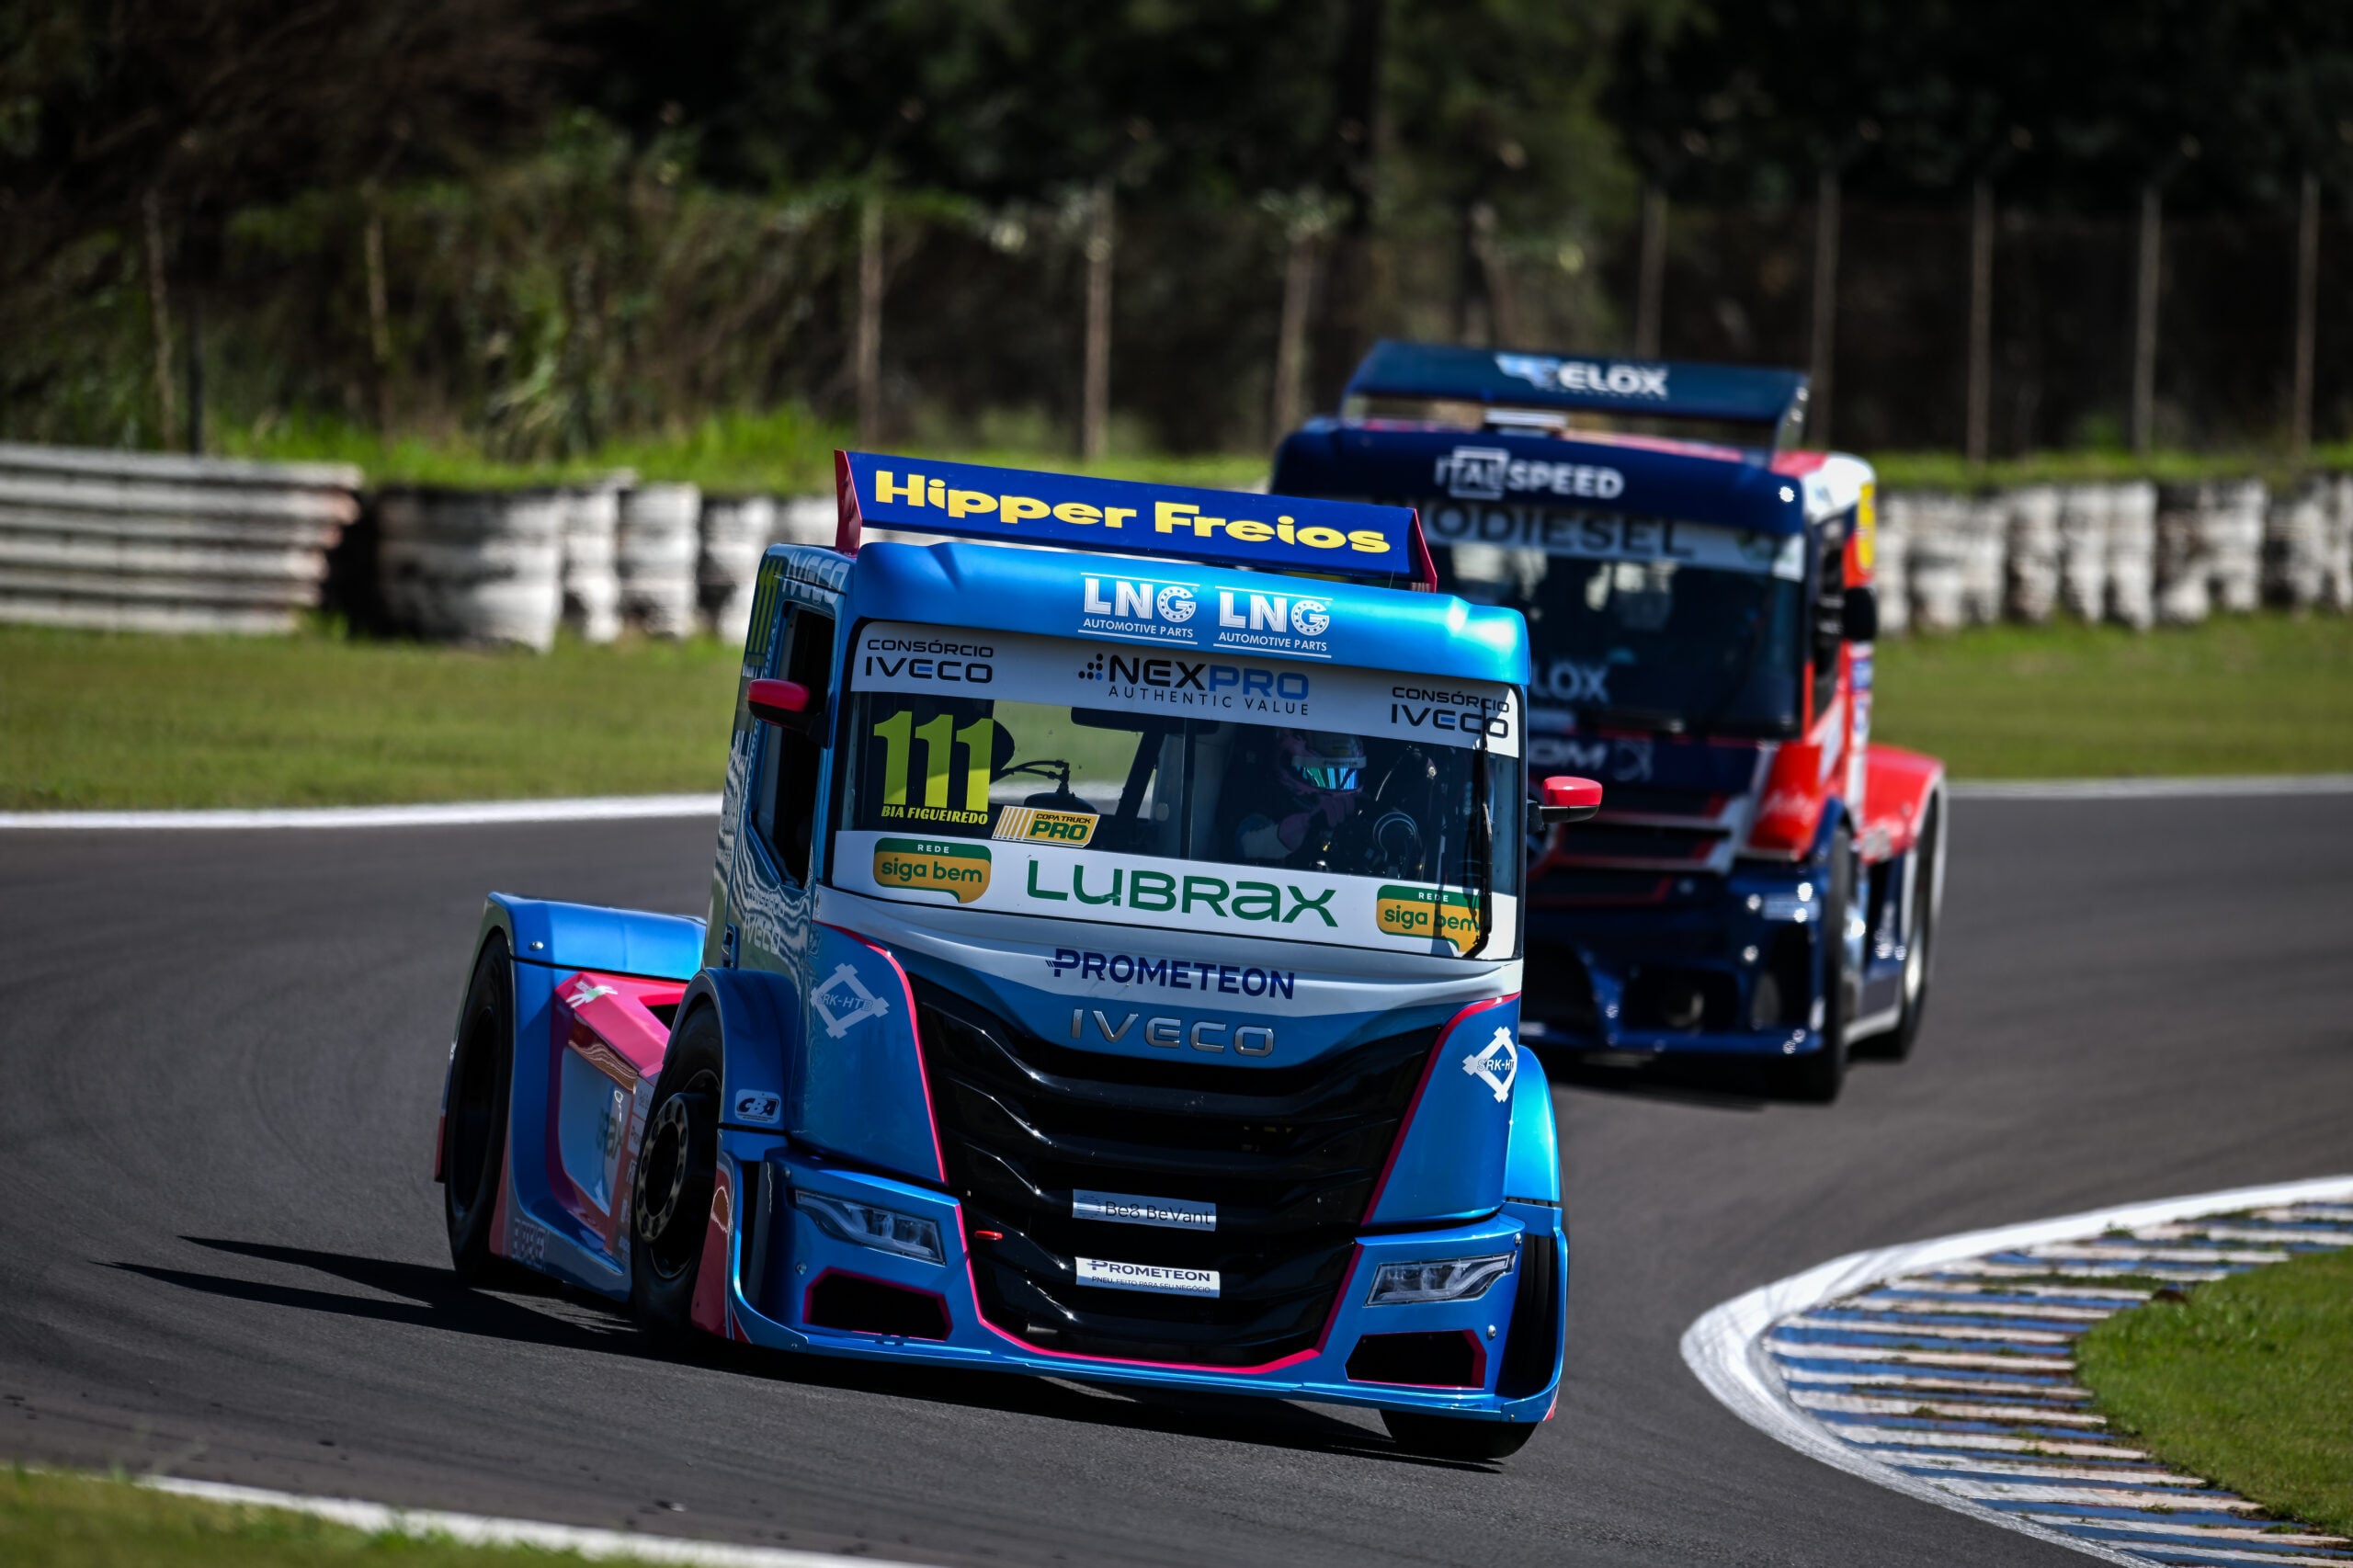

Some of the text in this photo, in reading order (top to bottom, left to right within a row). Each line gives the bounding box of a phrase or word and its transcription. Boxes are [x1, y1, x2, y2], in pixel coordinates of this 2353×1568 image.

[876, 471, 1391, 553] Hipper Freios
[1084, 578, 1197, 623] LNG
[1219, 591, 1330, 636] LNG
[1083, 618, 1194, 638] AUTOMOTIVE PARTS
[868, 639, 994, 658] CONSÓRCIO
[1218, 631, 1327, 652] AUTOMOTIVE PARTS
[866, 656, 993, 684] IVECO
[1108, 654, 1310, 700] NEXPRO
[1108, 685, 1309, 716] AUTHENTIC VALUE
[1392, 687, 1510, 713] CONSÓRCIO
[1391, 703, 1509, 739] IVECO
[874, 710, 994, 812] 111
[881, 805, 989, 825] BIA FIGUEIREDO
[1036, 812, 1091, 824] COPA TRUCK
[1029, 821, 1089, 841] PRO
[917, 844, 950, 854] REDE
[881, 857, 983, 883] siga bem
[1418, 892, 1449, 903] REDE
[1384, 904, 1428, 930] siga
[1046, 948, 1295, 1000] PROMETEON
[1070, 1008, 1275, 1058] IVECO
[1105, 1200, 1211, 1225] Be8 BeVant
[1087, 1259, 1211, 1282] PROMETEON
[1116, 1278, 1137, 1287] FEITO
[1139, 1280, 1158, 1289] PARA
[1159, 1282, 1175, 1290] SEU
